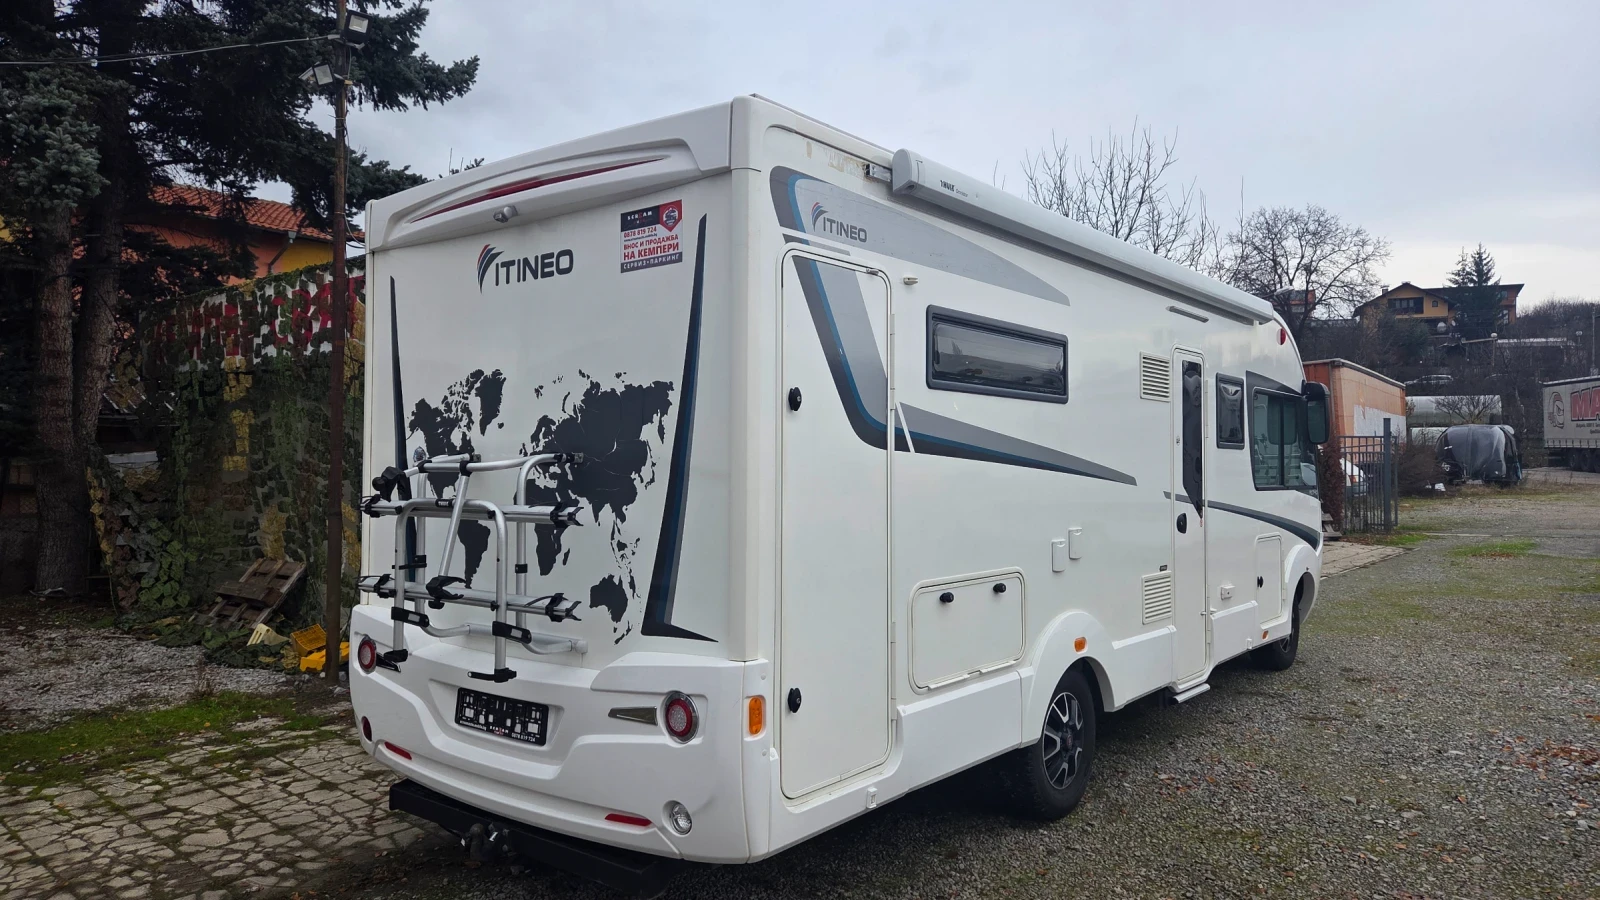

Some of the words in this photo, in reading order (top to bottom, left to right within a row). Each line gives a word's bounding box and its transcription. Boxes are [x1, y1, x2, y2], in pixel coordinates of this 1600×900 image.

[624, 230, 636, 238] 0878
[637, 228, 646, 236] 819
[823, 216, 868, 243] ITINEO
[624, 242, 638, 250] ВНОС
[645, 234, 679, 246] ПРОДАЖБА
[624, 251, 635, 261] НА
[638, 242, 679, 258] КЕМПЕРИ
[495, 249, 574, 287] ITINEO
